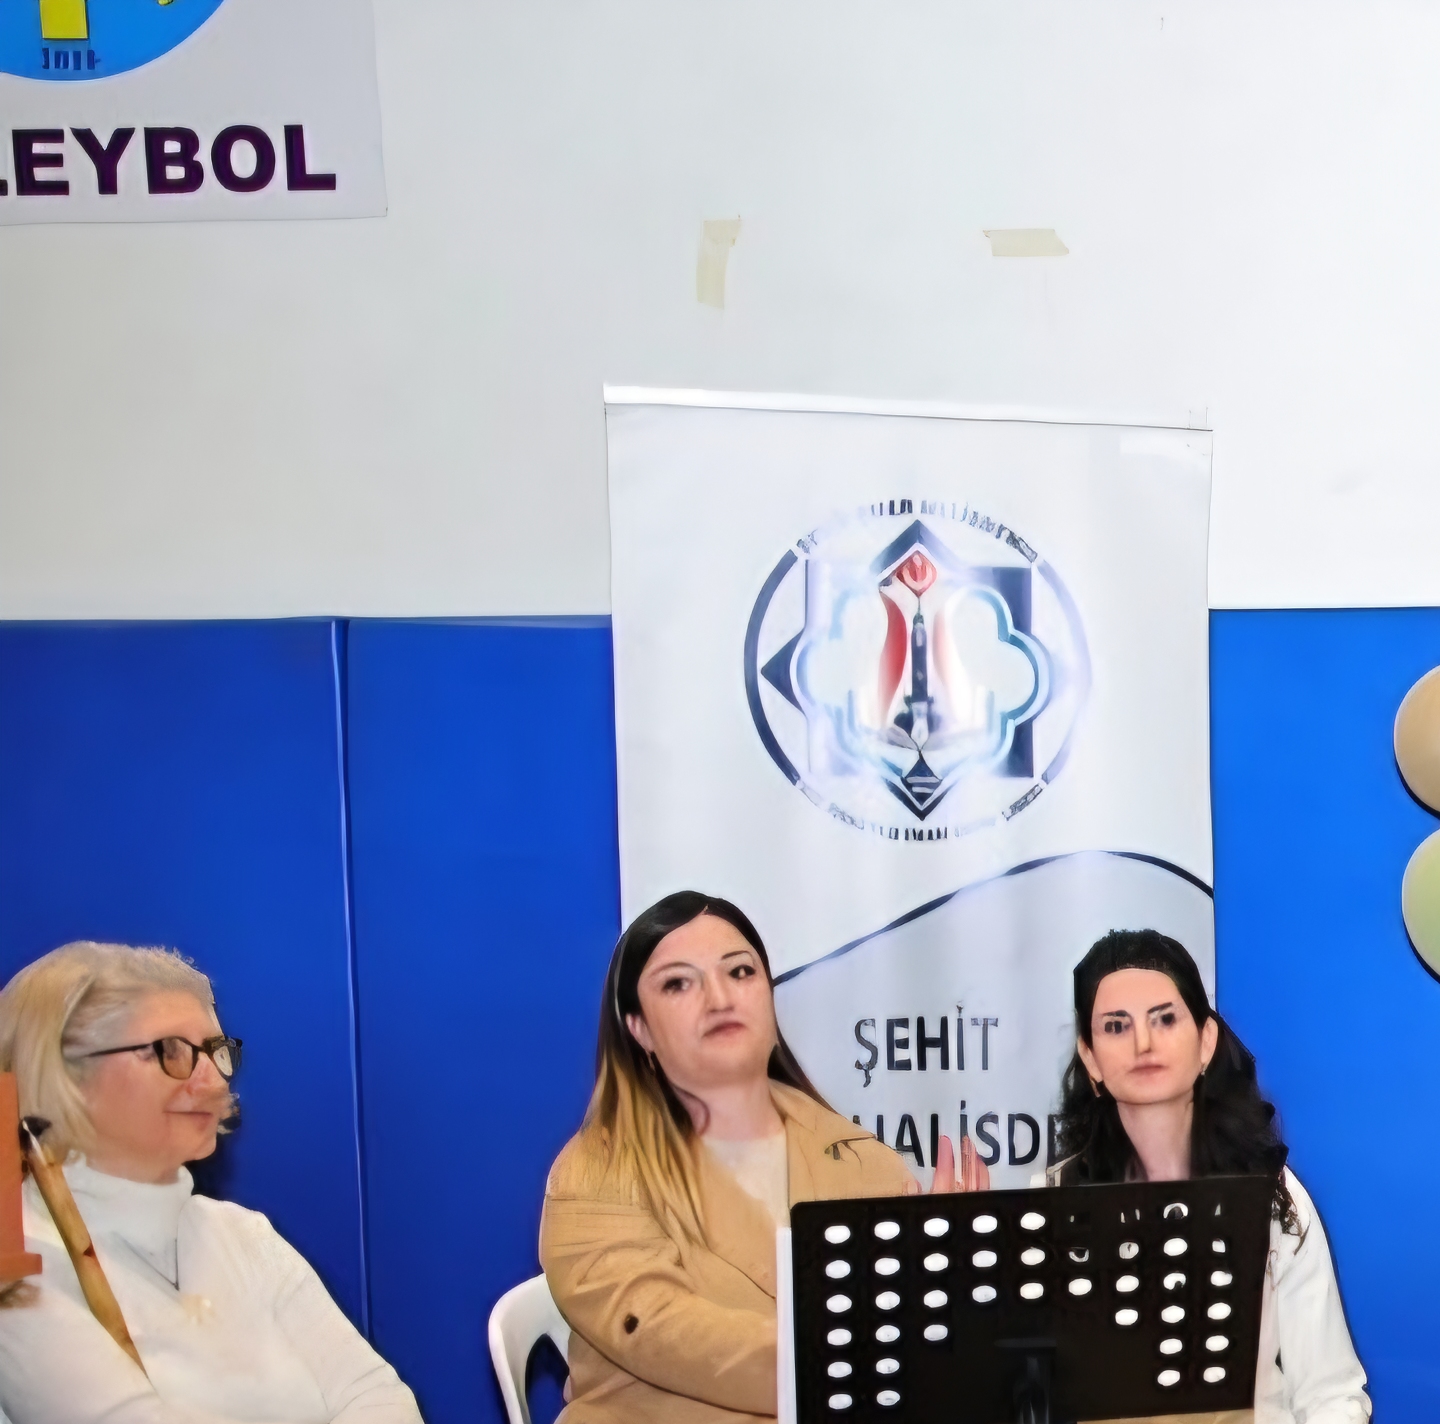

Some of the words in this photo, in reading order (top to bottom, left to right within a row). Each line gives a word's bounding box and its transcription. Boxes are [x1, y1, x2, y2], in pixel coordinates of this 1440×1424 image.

[0, 124, 337, 196] EYBOL
[853, 1000, 1000, 1089] ŞEHİT
[852, 1099, 1056, 1169] ALİSD
